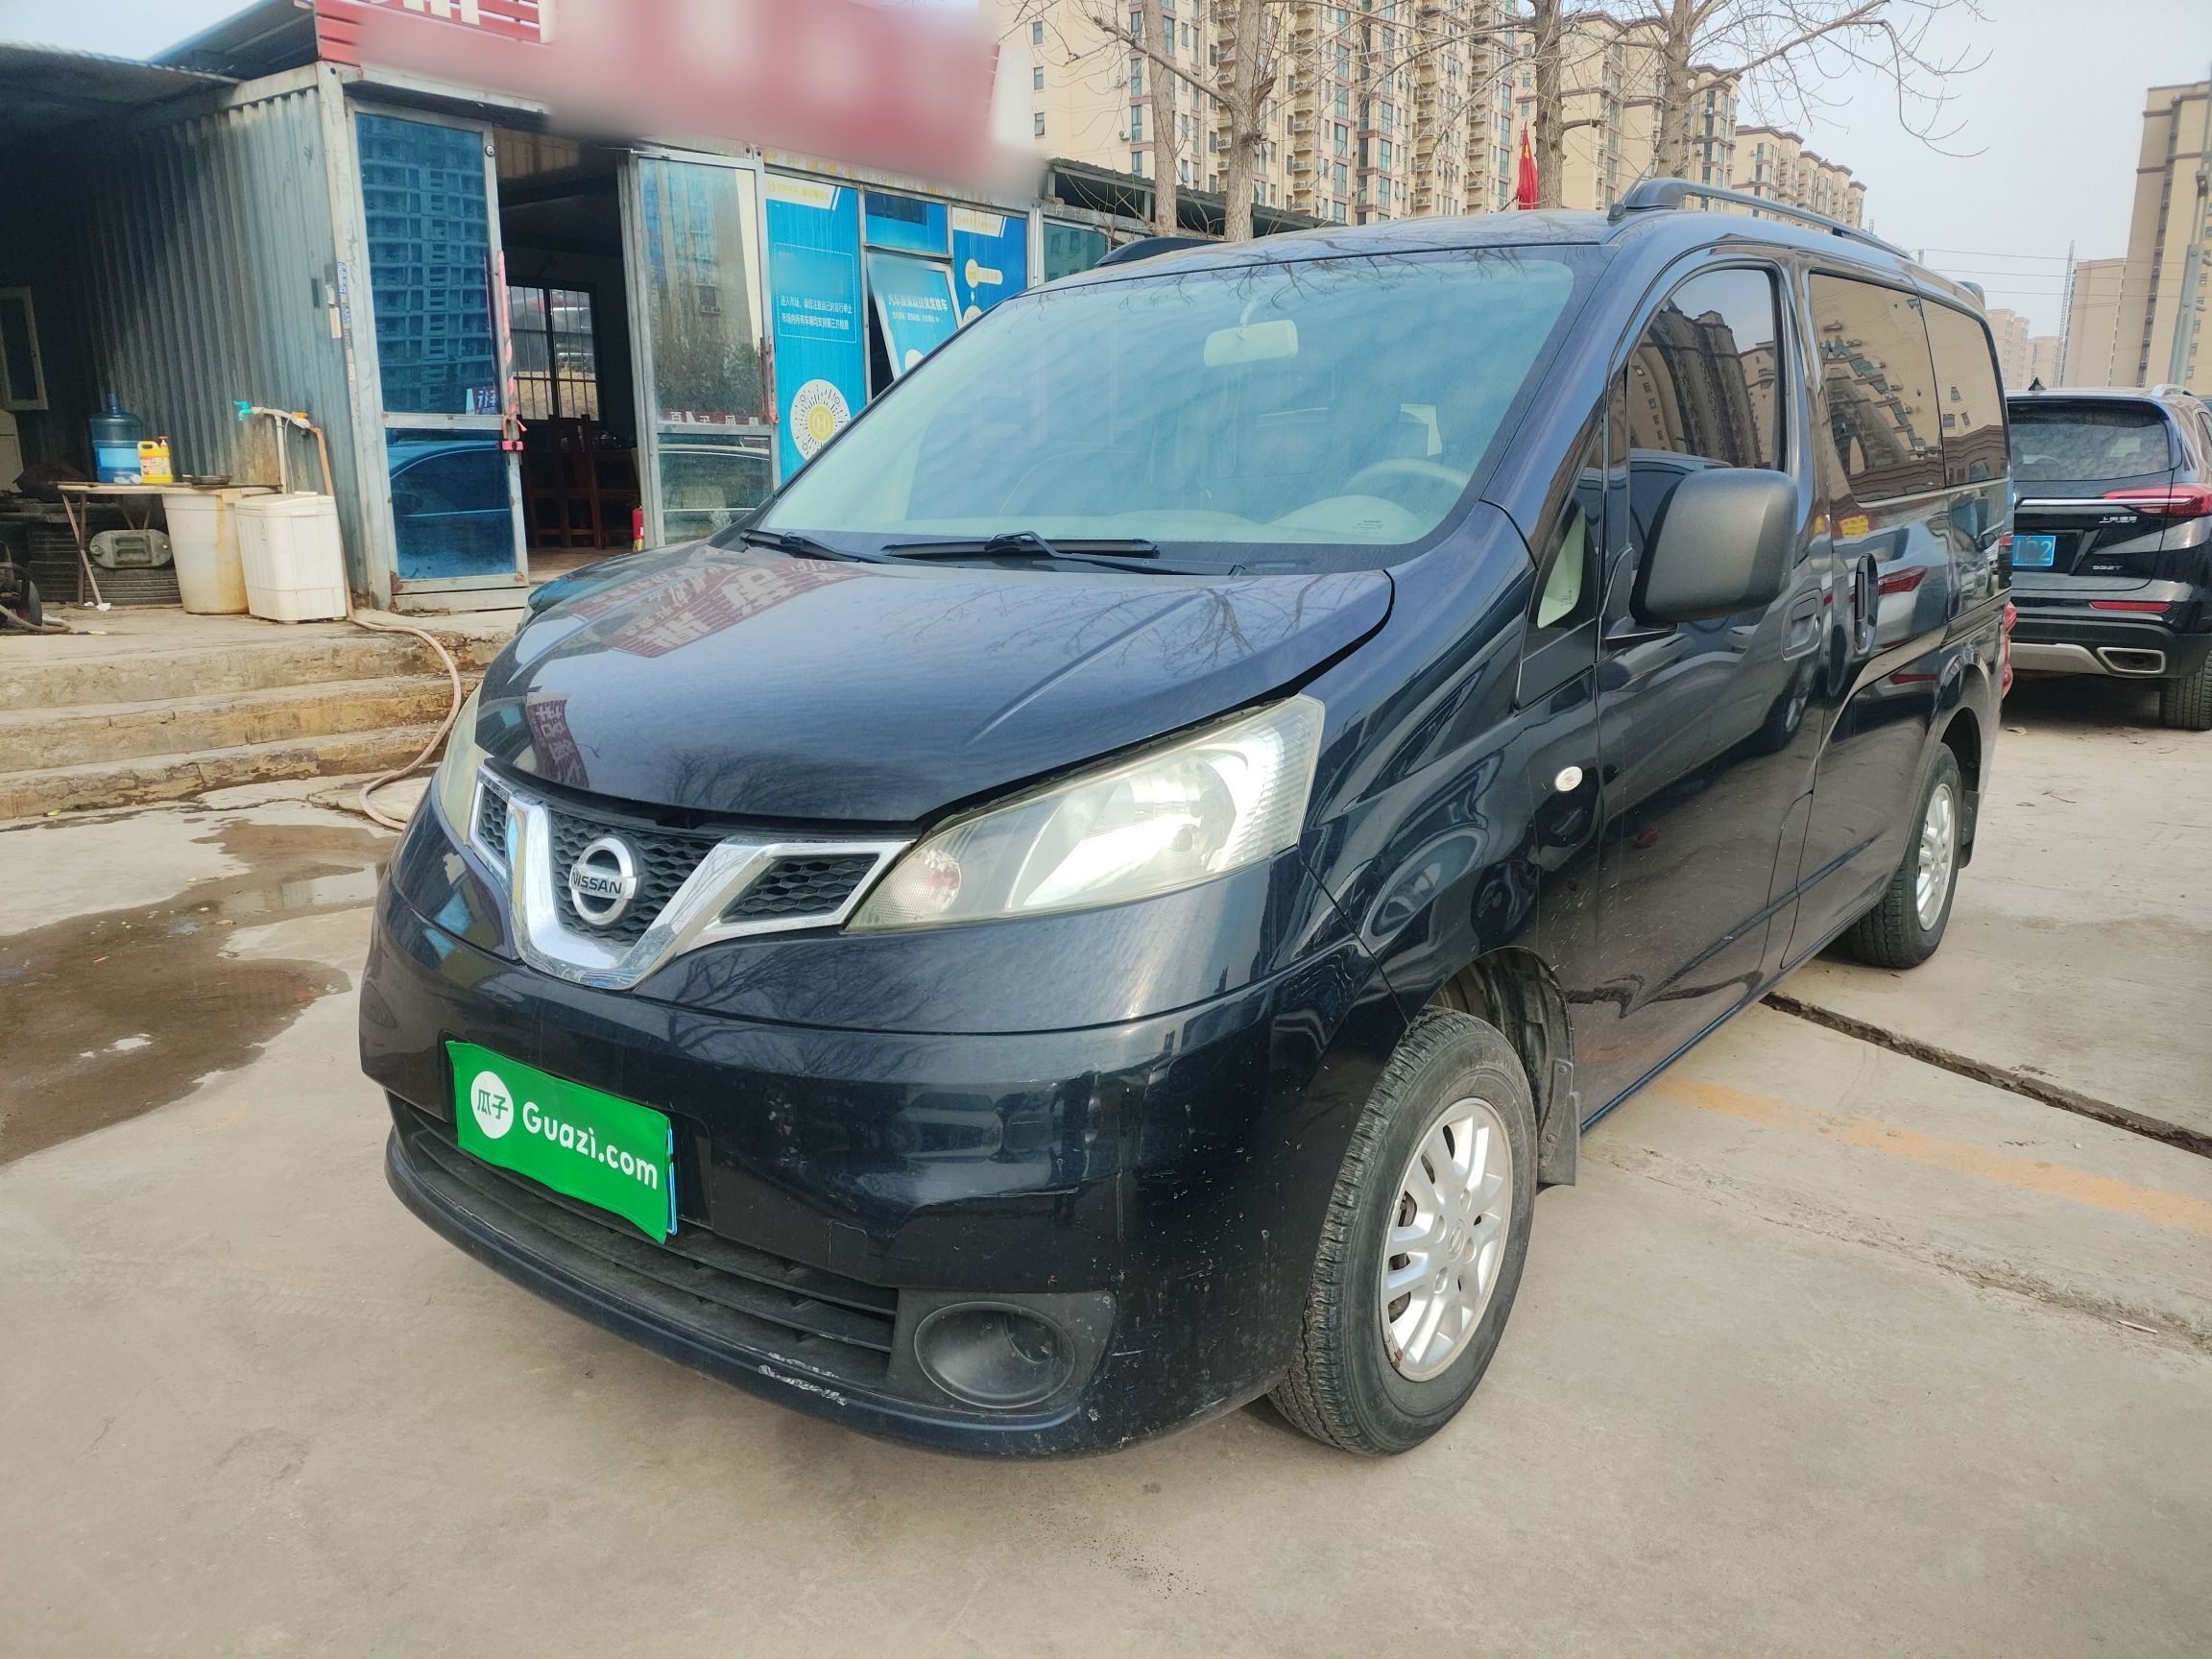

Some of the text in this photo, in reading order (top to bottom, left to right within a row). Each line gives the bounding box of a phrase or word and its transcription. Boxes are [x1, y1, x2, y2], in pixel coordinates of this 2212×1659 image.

[570, 871, 624, 896] NISSAN
[477, 1089, 509, 1120] 瓜子
[522, 1100, 659, 1190] Guazi.com
